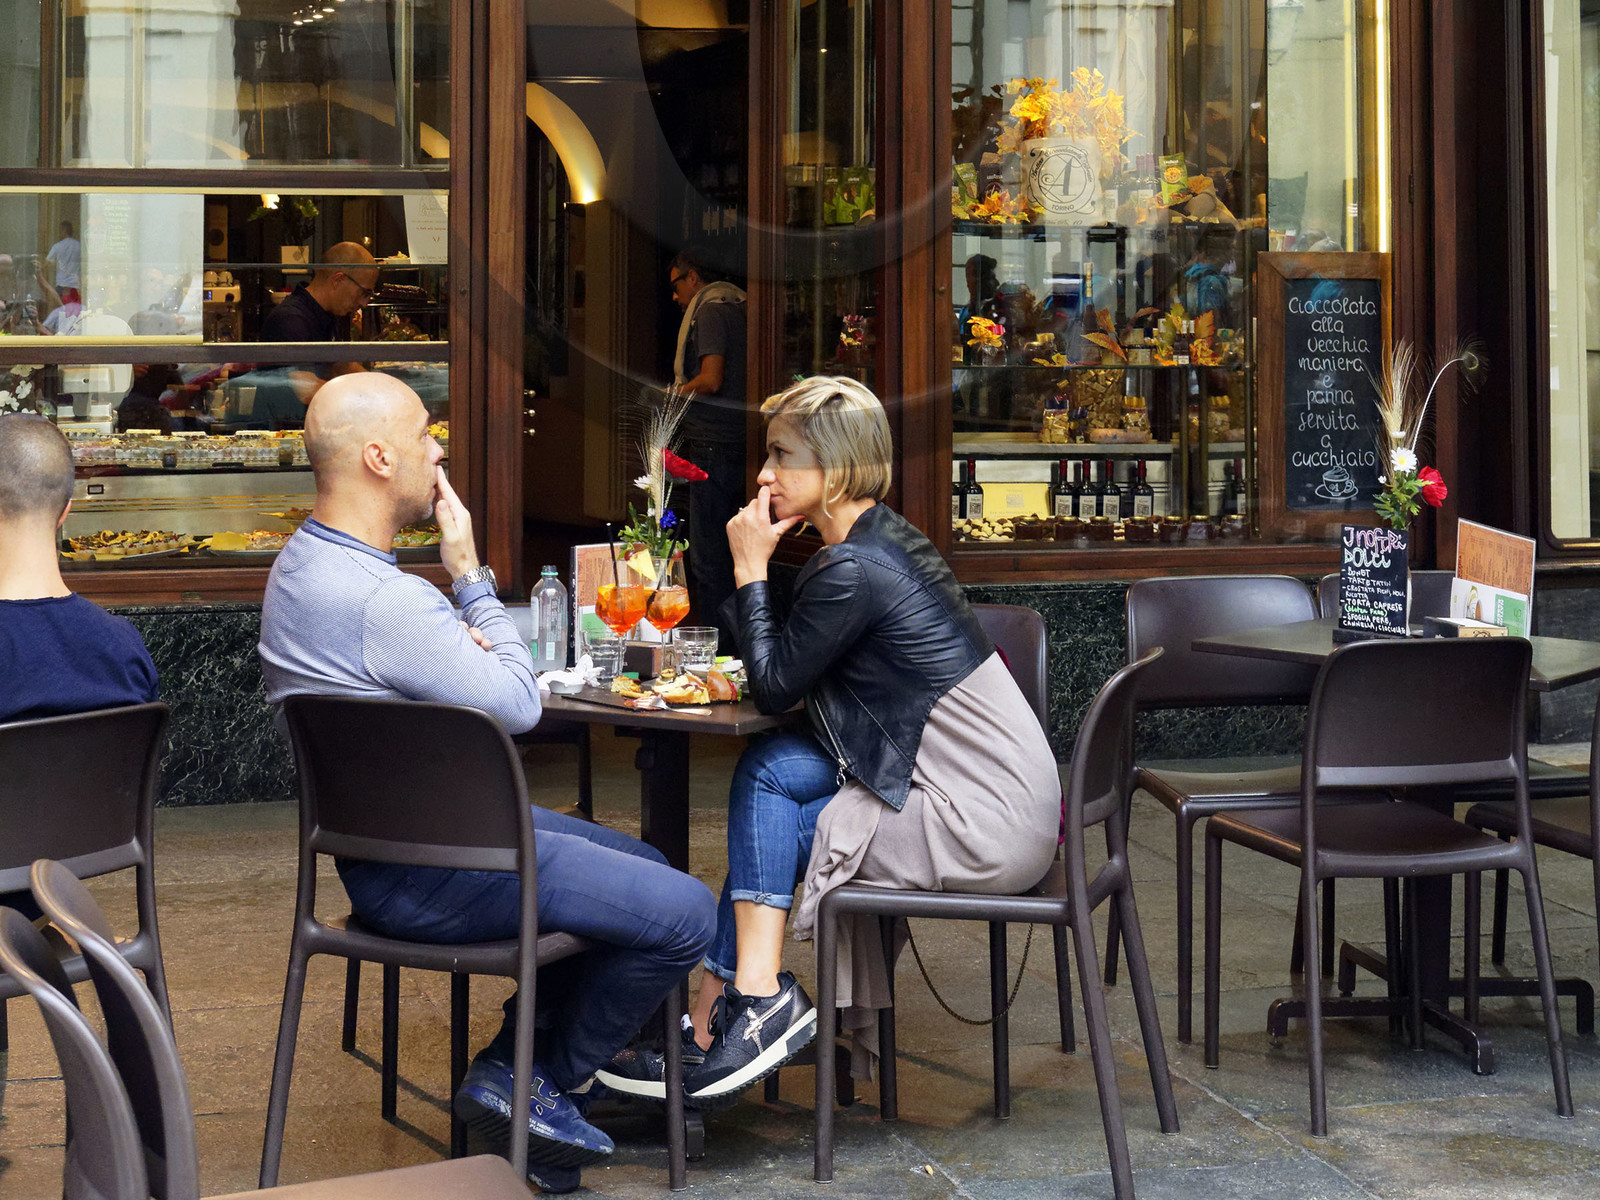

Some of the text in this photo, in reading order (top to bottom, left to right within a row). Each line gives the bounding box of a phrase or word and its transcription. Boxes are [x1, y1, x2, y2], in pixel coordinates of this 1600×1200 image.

[1288, 296, 1376, 316] Cioccolata
[1311, 316, 1344, 333] alla
[1298, 356, 1364, 372] maniera
[1323, 374, 1333, 388] e
[1307, 389, 1355, 411] panna
[1320, 434, 1331, 448] a
[1346, 598, 1371, 608] TORTA
